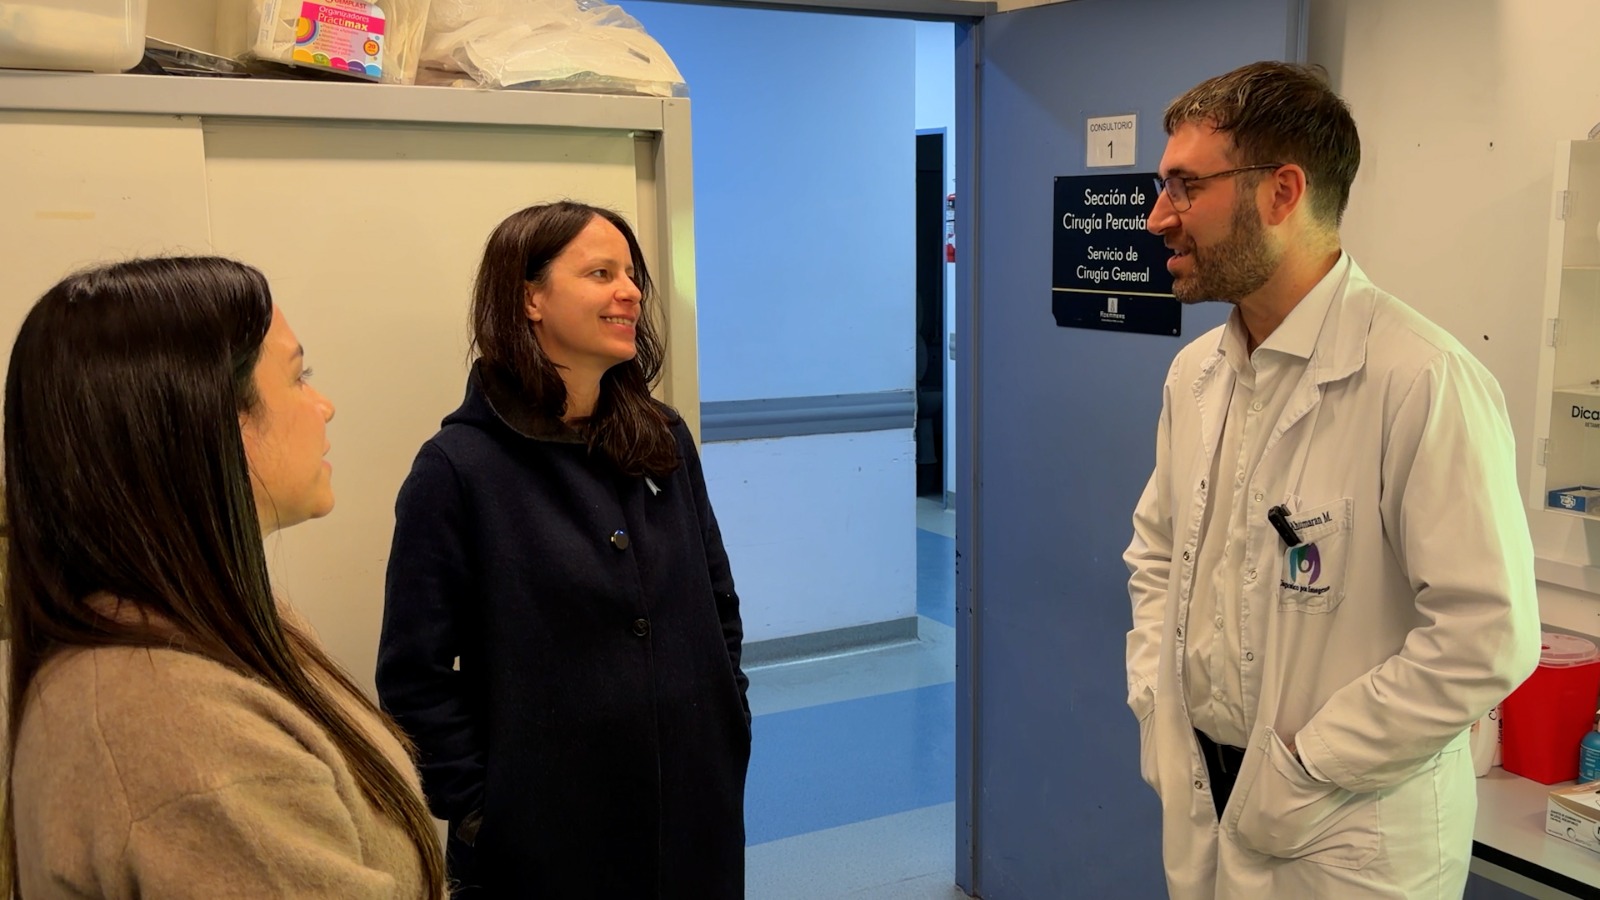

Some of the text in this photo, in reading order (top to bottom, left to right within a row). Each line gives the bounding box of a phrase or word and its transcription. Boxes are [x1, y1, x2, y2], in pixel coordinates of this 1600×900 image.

[318, 5, 369, 23] Organizadores
[1090, 121, 1133, 132] CONSULTORIO
[1107, 140, 1113, 159] 1
[1084, 186, 1145, 206] Sección de
[1062, 212, 1149, 235] Cirugía Percutá
[1087, 246, 1138, 262] Servicio de
[1076, 265, 1150, 284] Cirugía General
